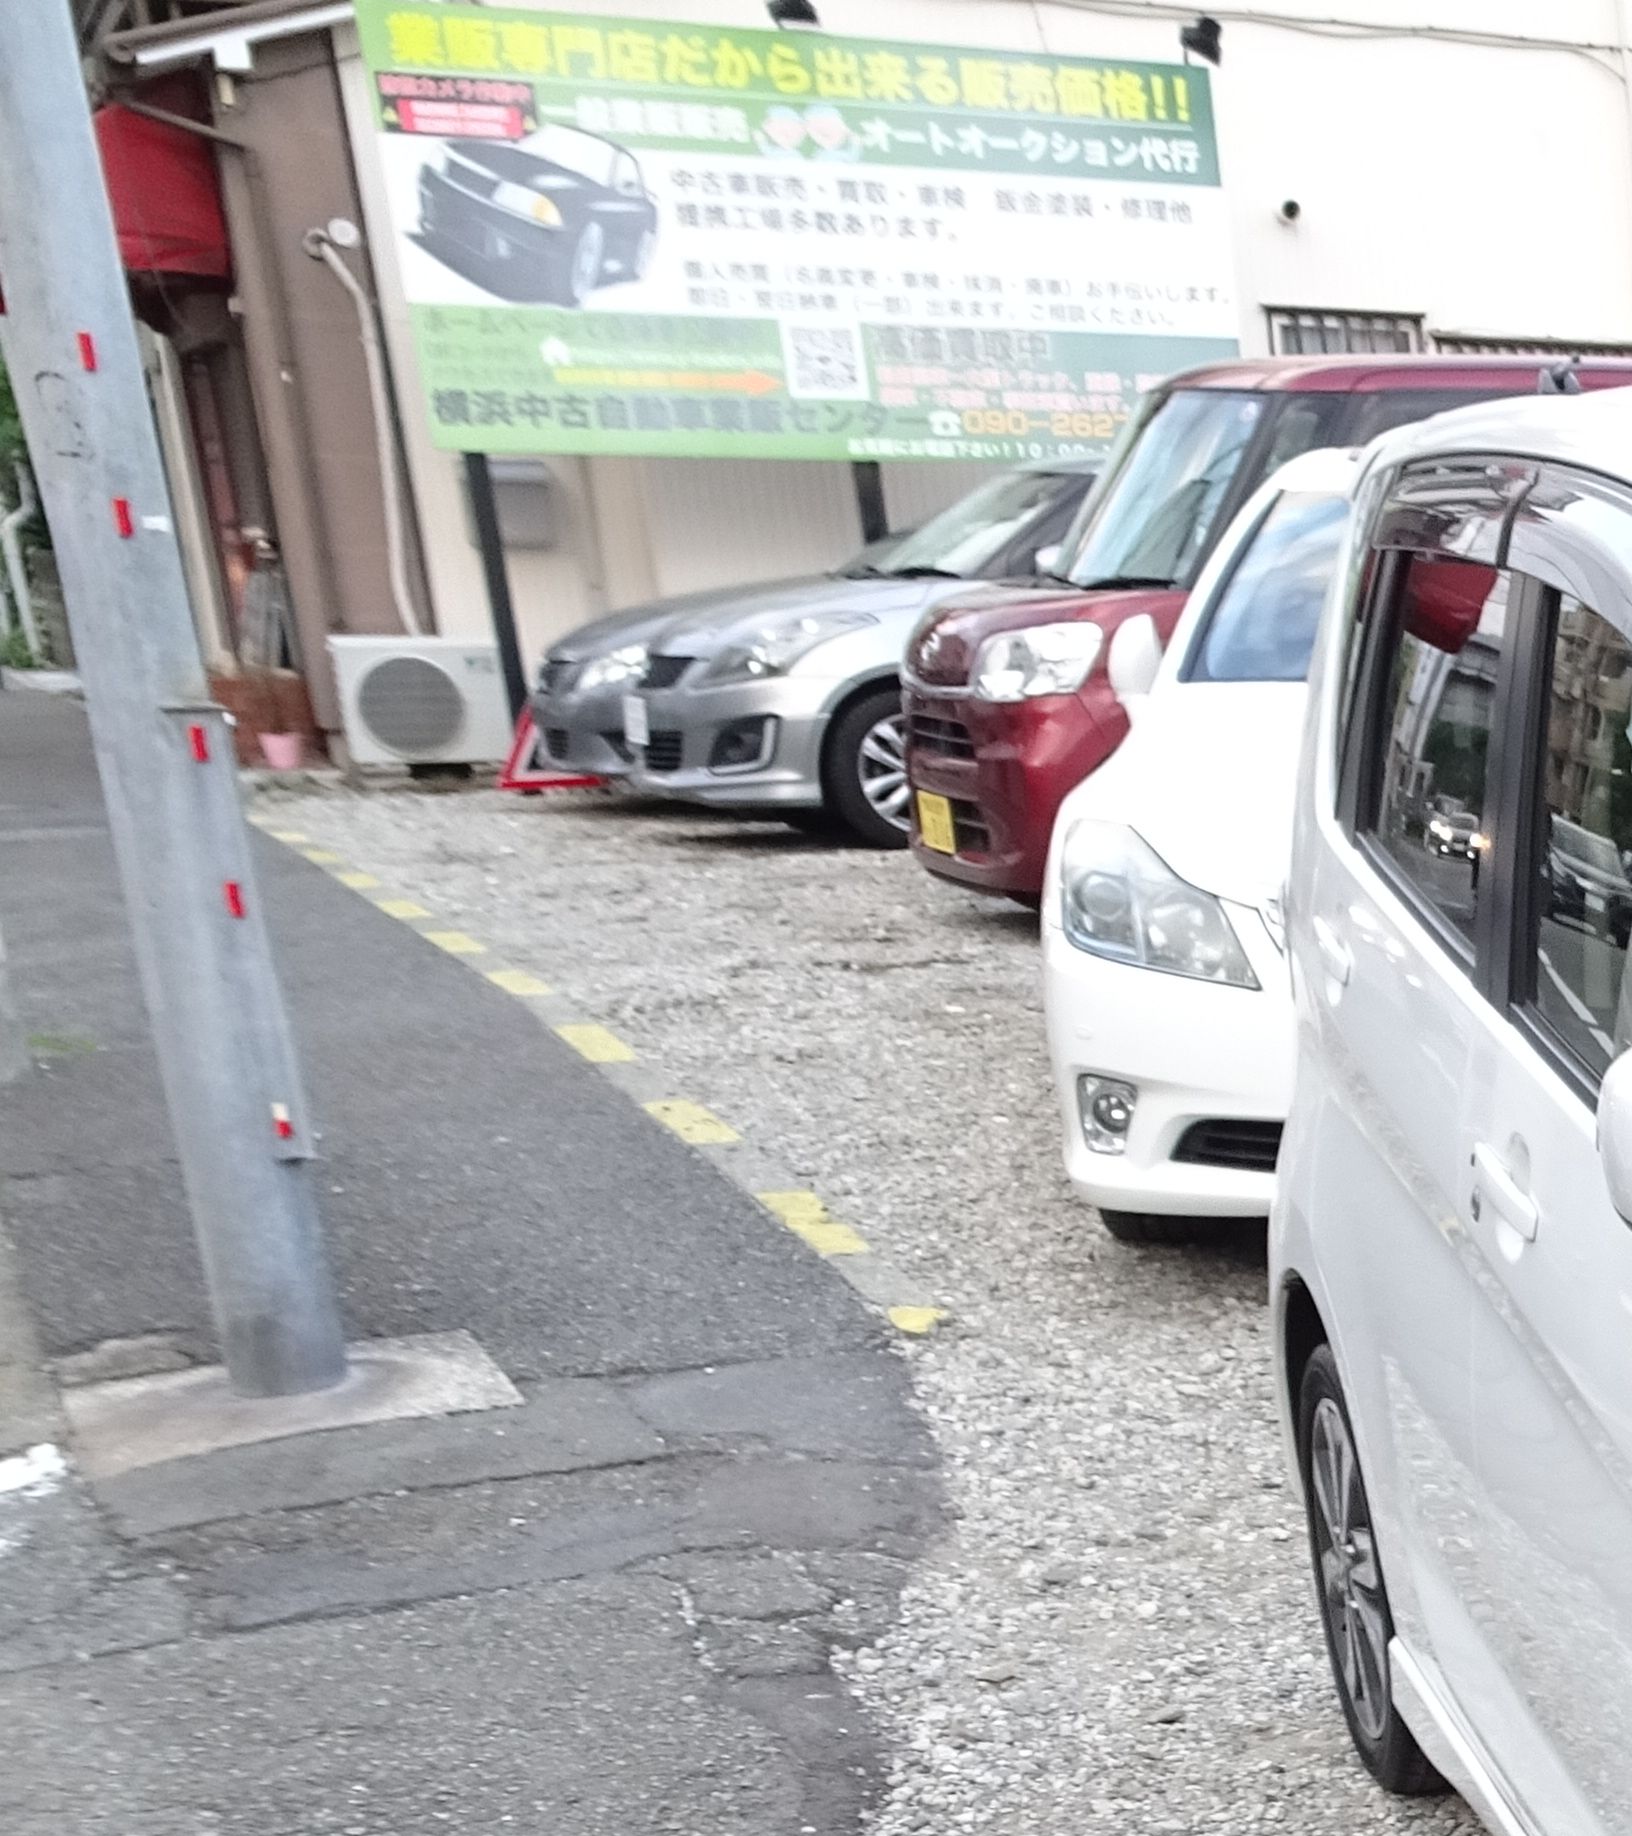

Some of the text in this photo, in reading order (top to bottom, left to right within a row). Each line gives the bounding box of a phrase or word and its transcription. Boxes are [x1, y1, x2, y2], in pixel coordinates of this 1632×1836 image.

[859, 117, 1199, 175] オートオークション代行
